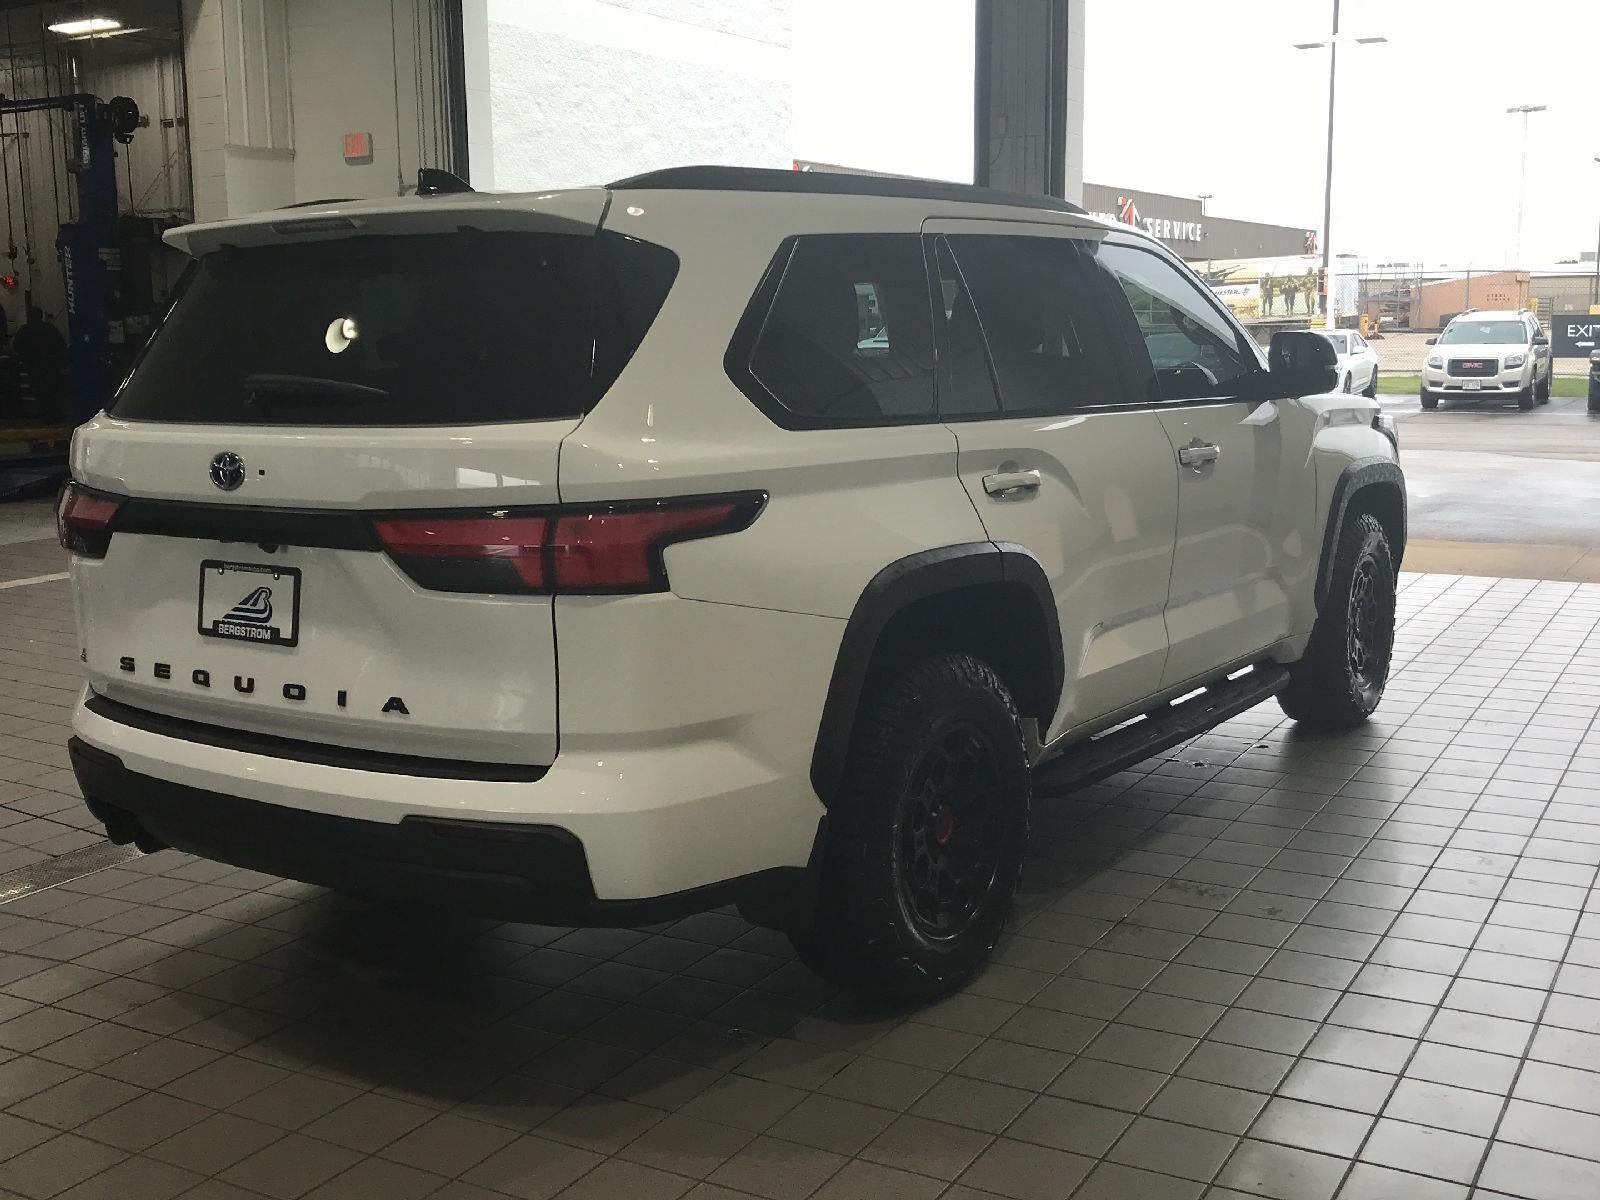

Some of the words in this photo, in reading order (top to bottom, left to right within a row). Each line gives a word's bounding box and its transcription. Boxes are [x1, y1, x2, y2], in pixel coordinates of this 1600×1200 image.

[1144, 217, 1202, 241] SERVICE
[218, 623, 271, 640] BERGSTROM
[119, 656, 410, 715] SEQUOIA
